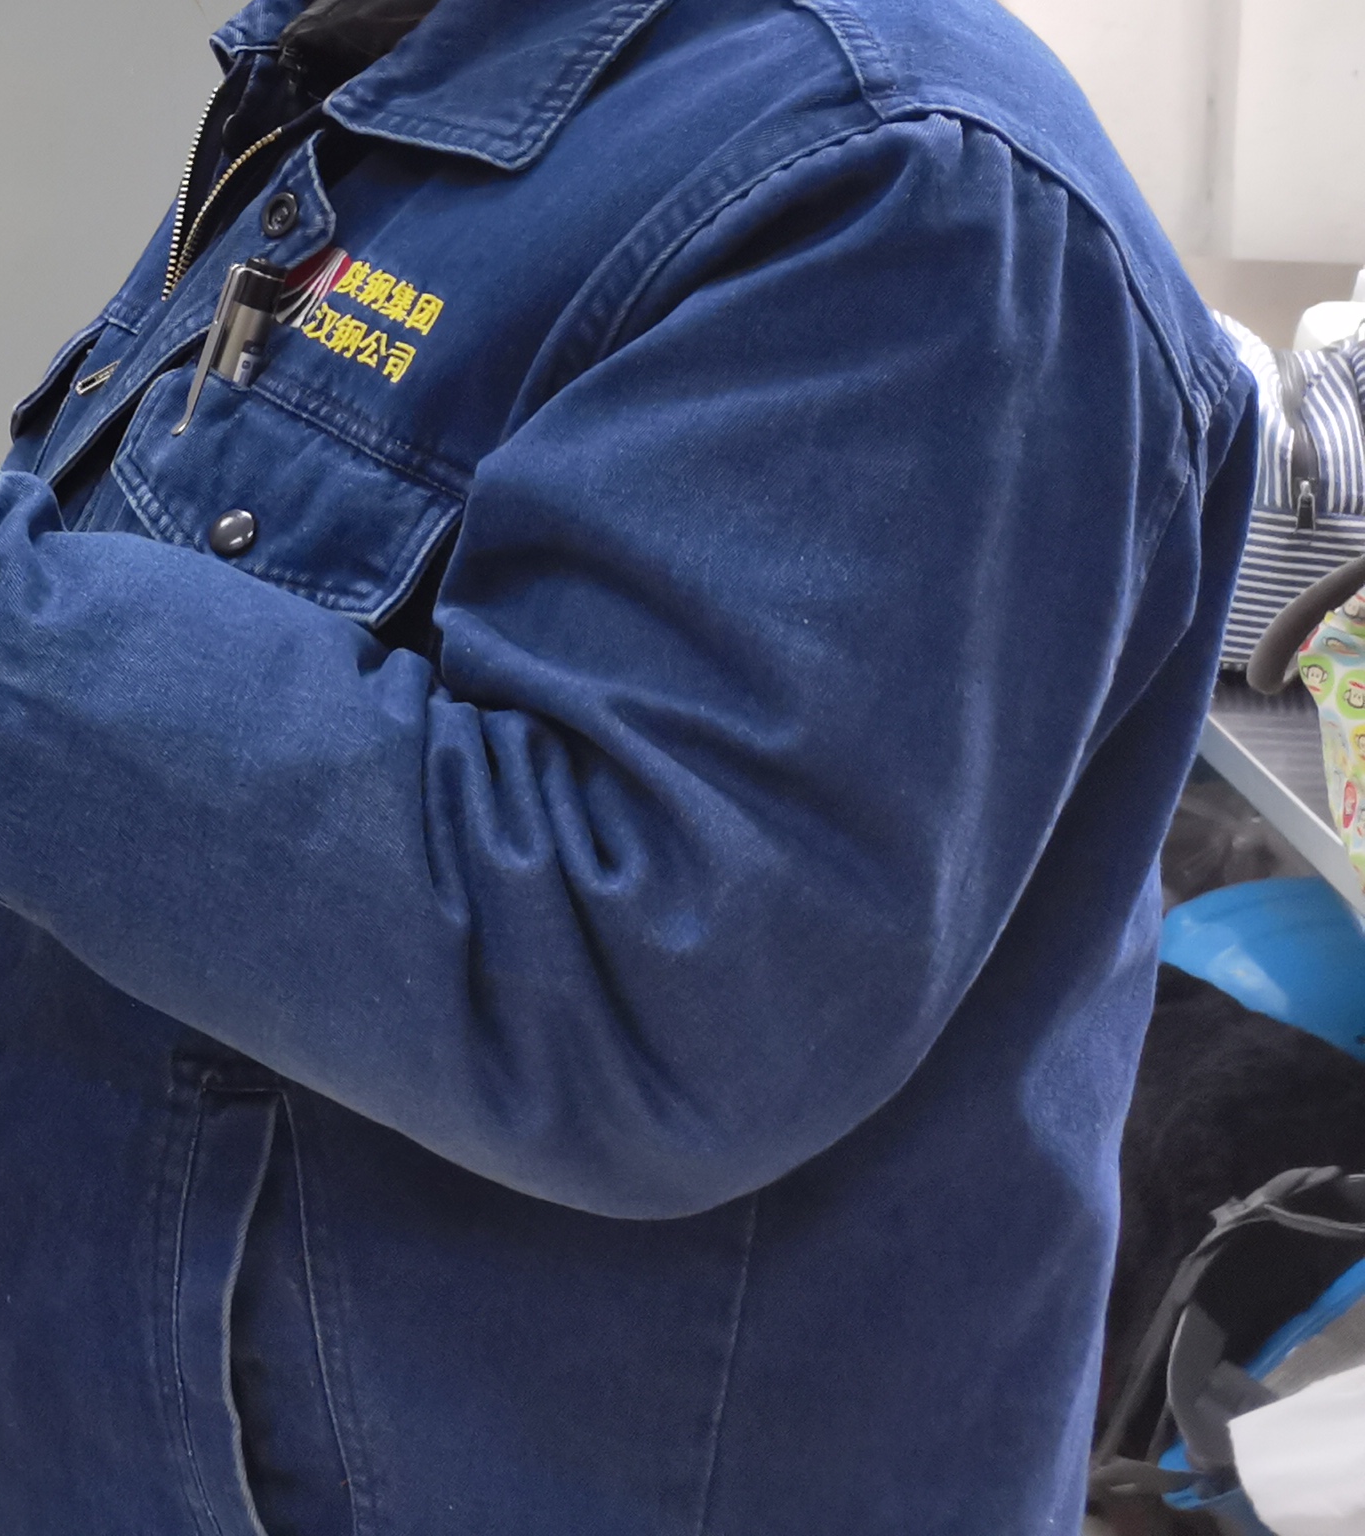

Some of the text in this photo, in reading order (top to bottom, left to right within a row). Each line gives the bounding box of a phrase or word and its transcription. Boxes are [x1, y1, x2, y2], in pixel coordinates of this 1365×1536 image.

[332, 260, 445, 336] 陕钢集团
[301, 301, 417, 384] 汉钢公司
